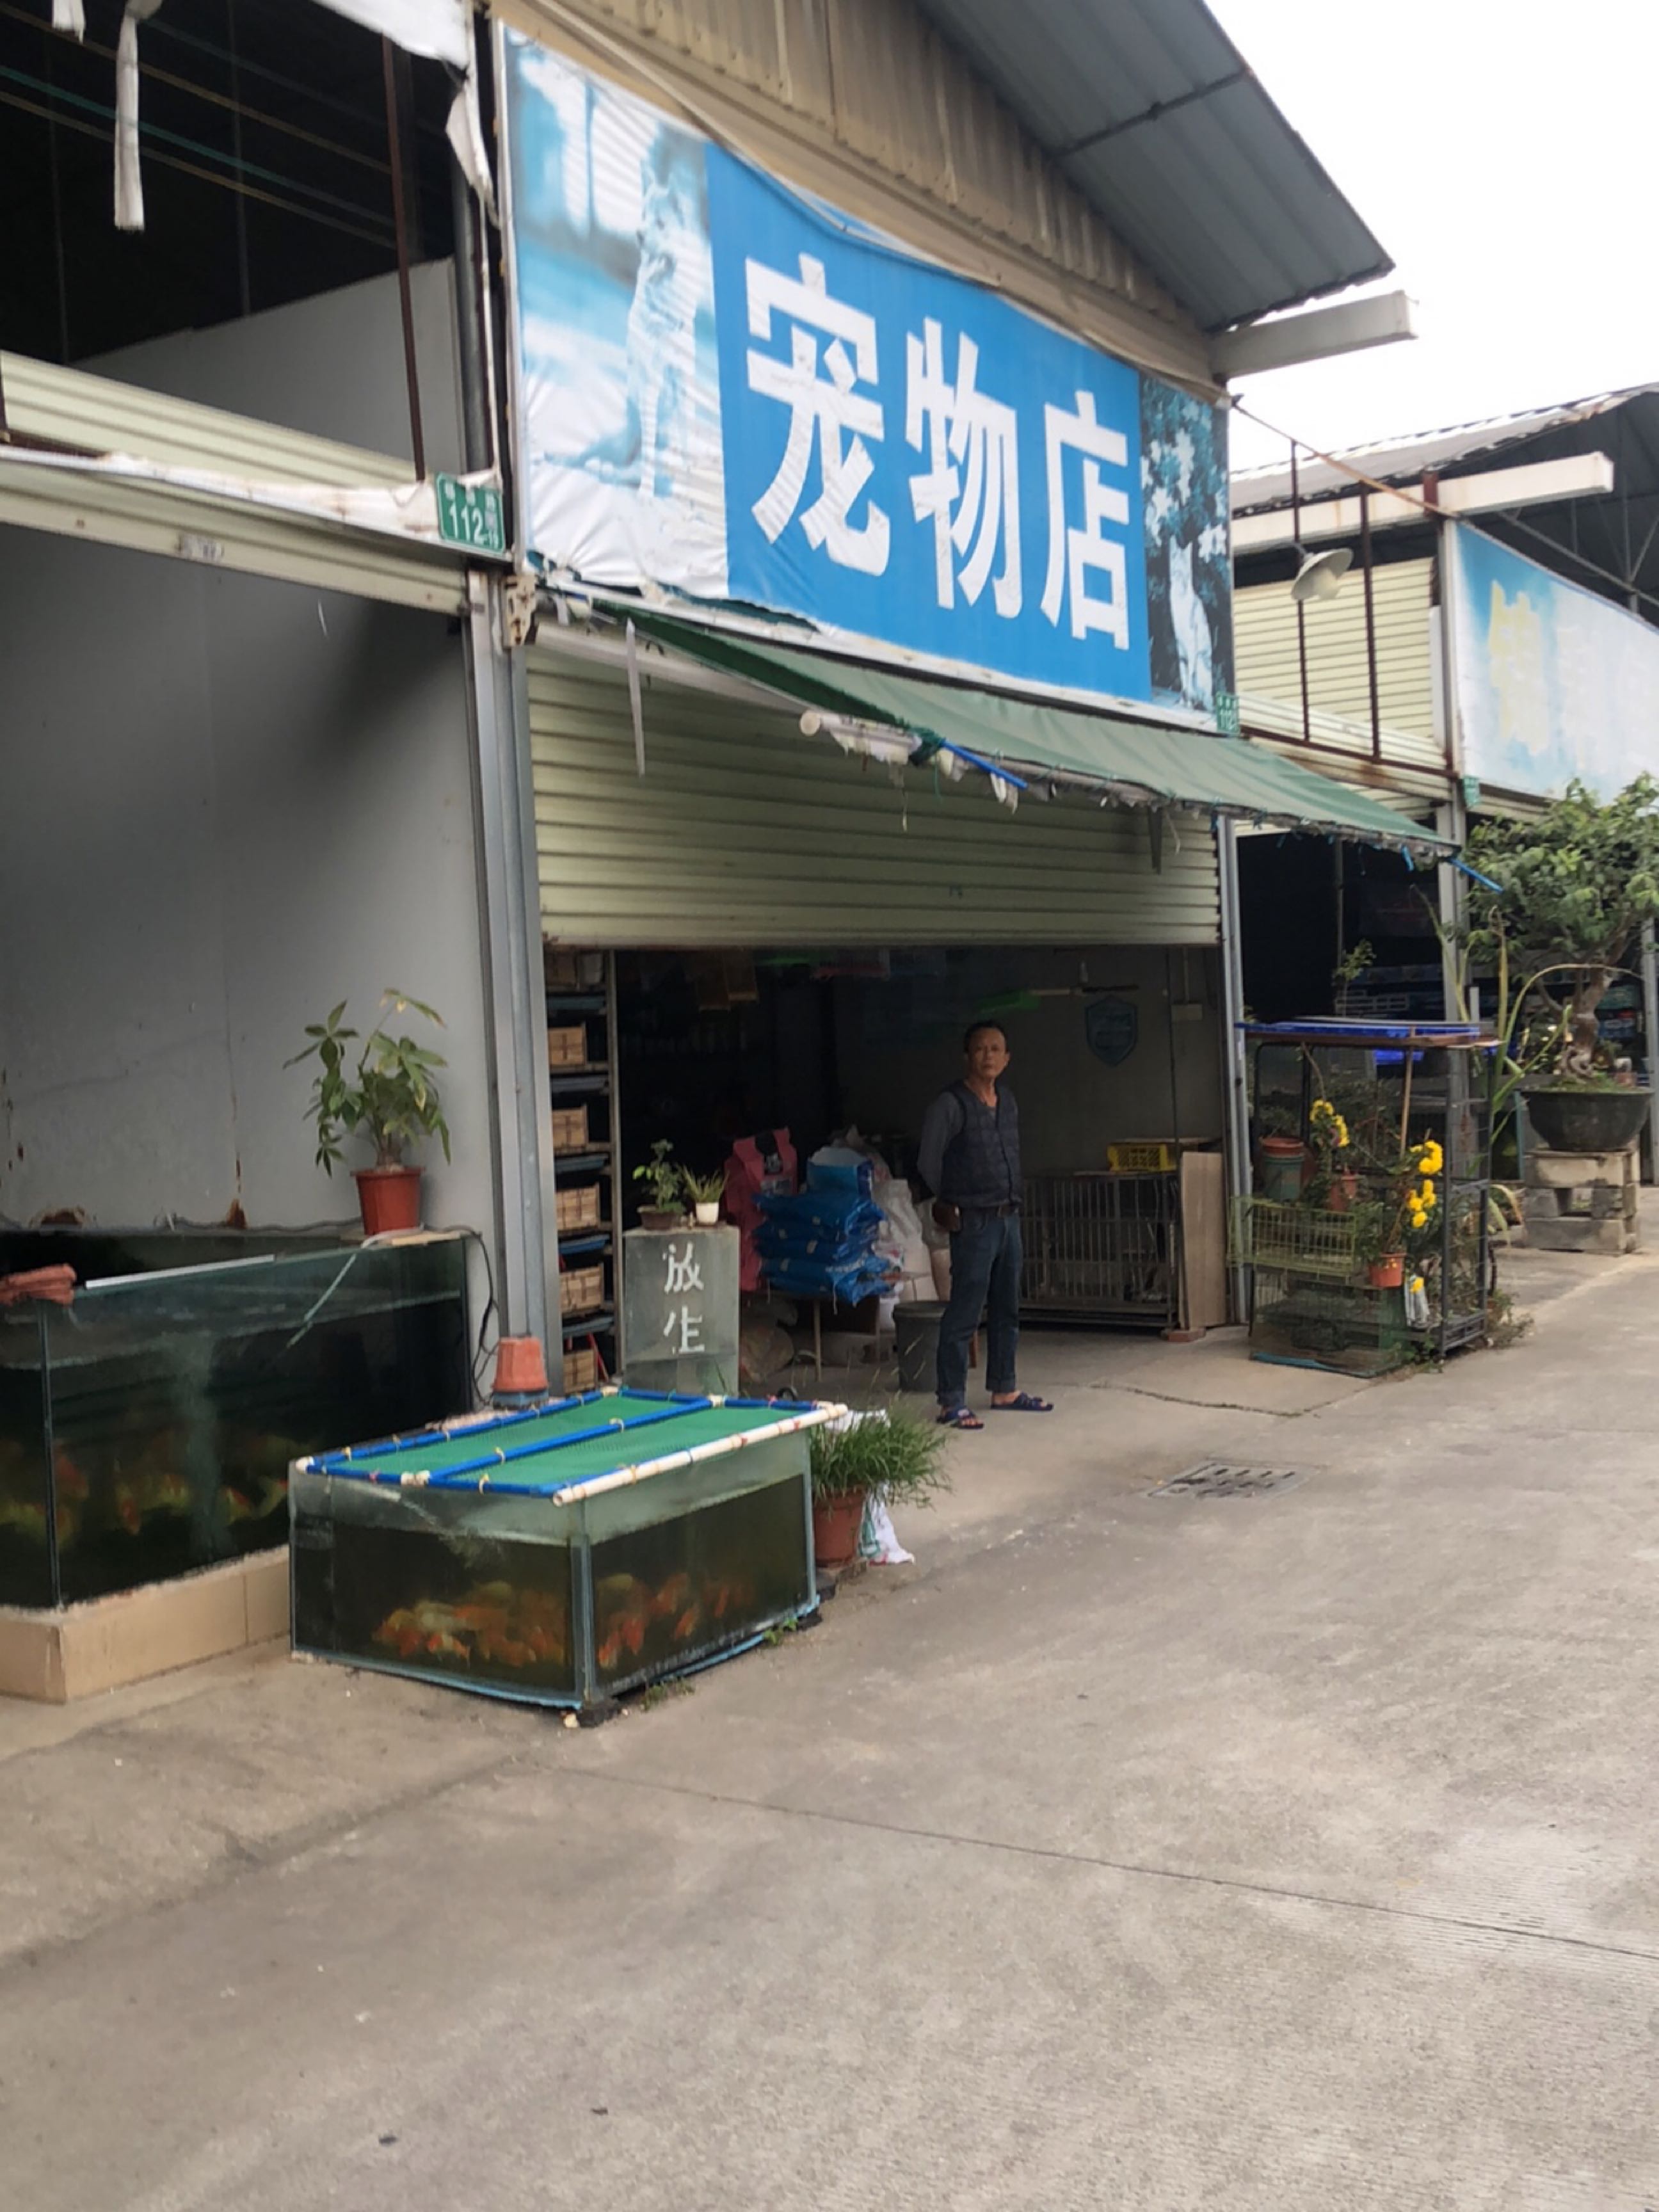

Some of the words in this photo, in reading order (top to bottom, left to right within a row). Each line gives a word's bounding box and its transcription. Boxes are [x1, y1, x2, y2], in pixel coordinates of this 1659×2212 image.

[745, 252, 1130, 650] 宠物店
[662, 1241, 705, 1354] 放生
